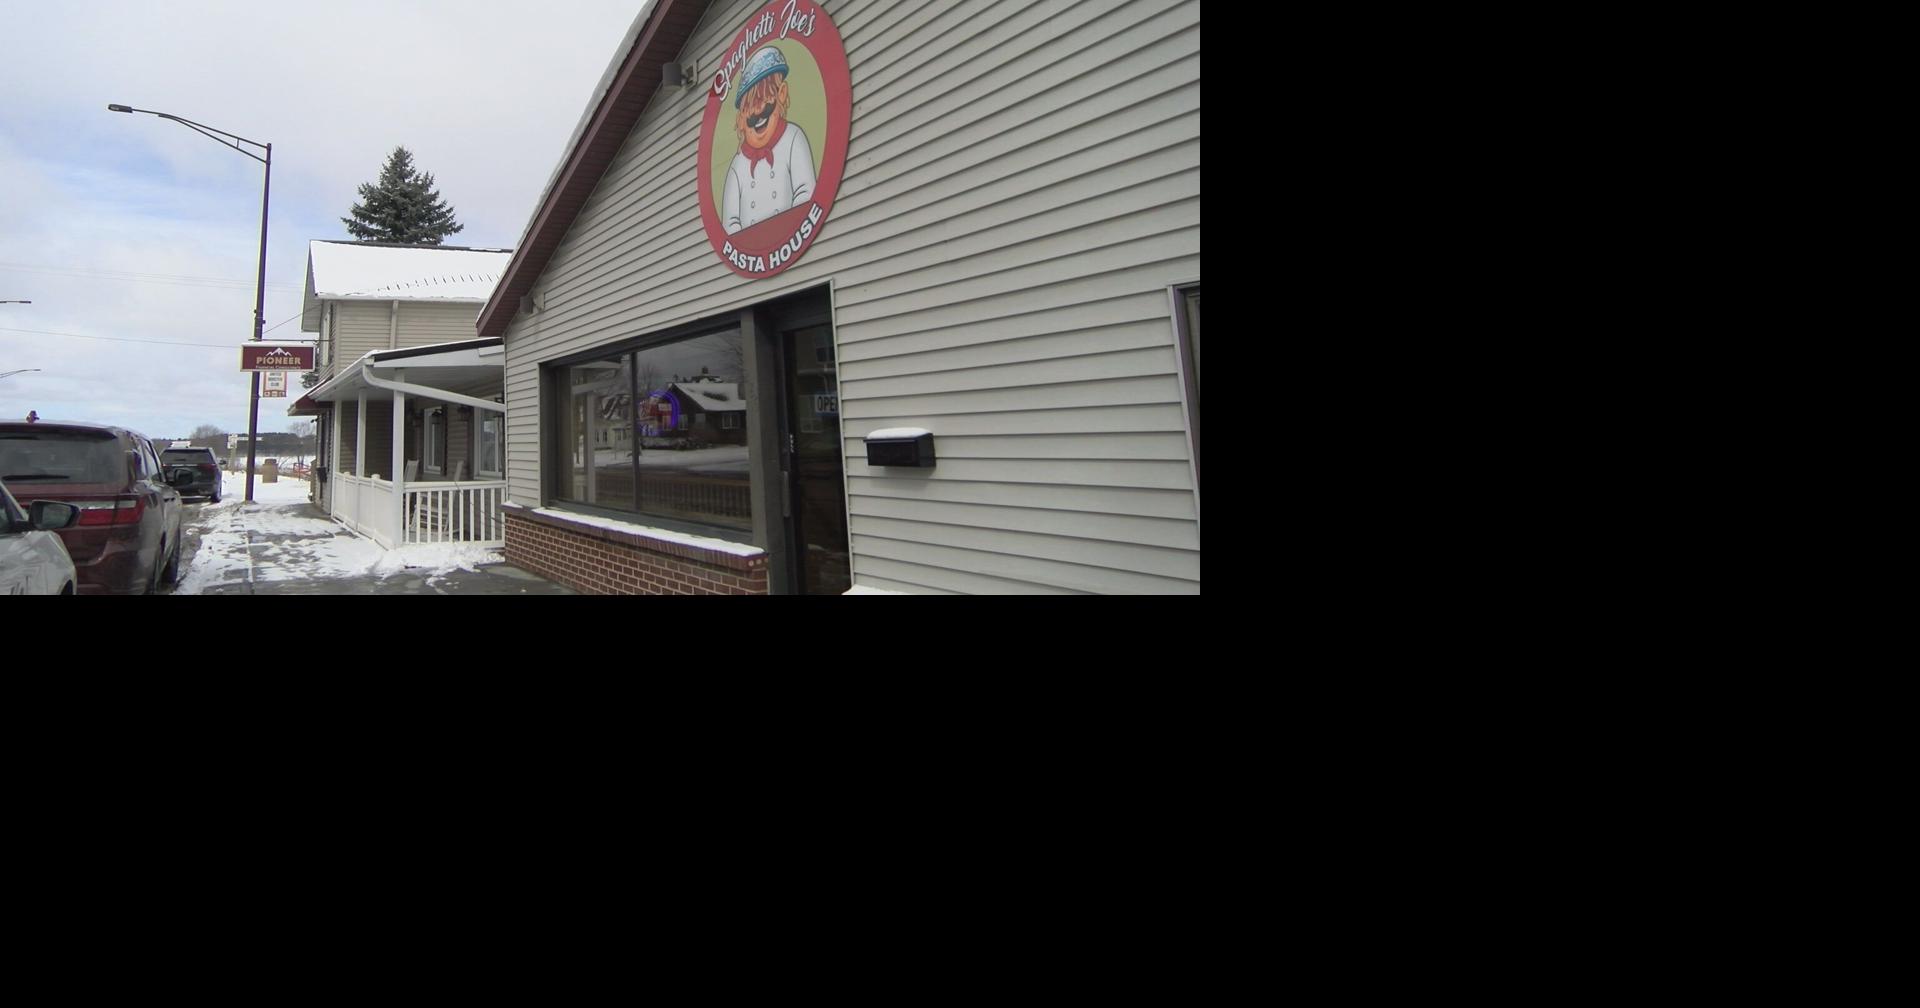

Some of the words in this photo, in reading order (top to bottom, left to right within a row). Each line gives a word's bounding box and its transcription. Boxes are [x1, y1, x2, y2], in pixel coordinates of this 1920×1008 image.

[713, 12, 775, 101] Spaghetti
[780, 0, 815, 39] Joe's
[723, 240, 766, 272] PASTA
[769, 203, 823, 269] HOUSE
[256, 356, 301, 365] PIONEER
